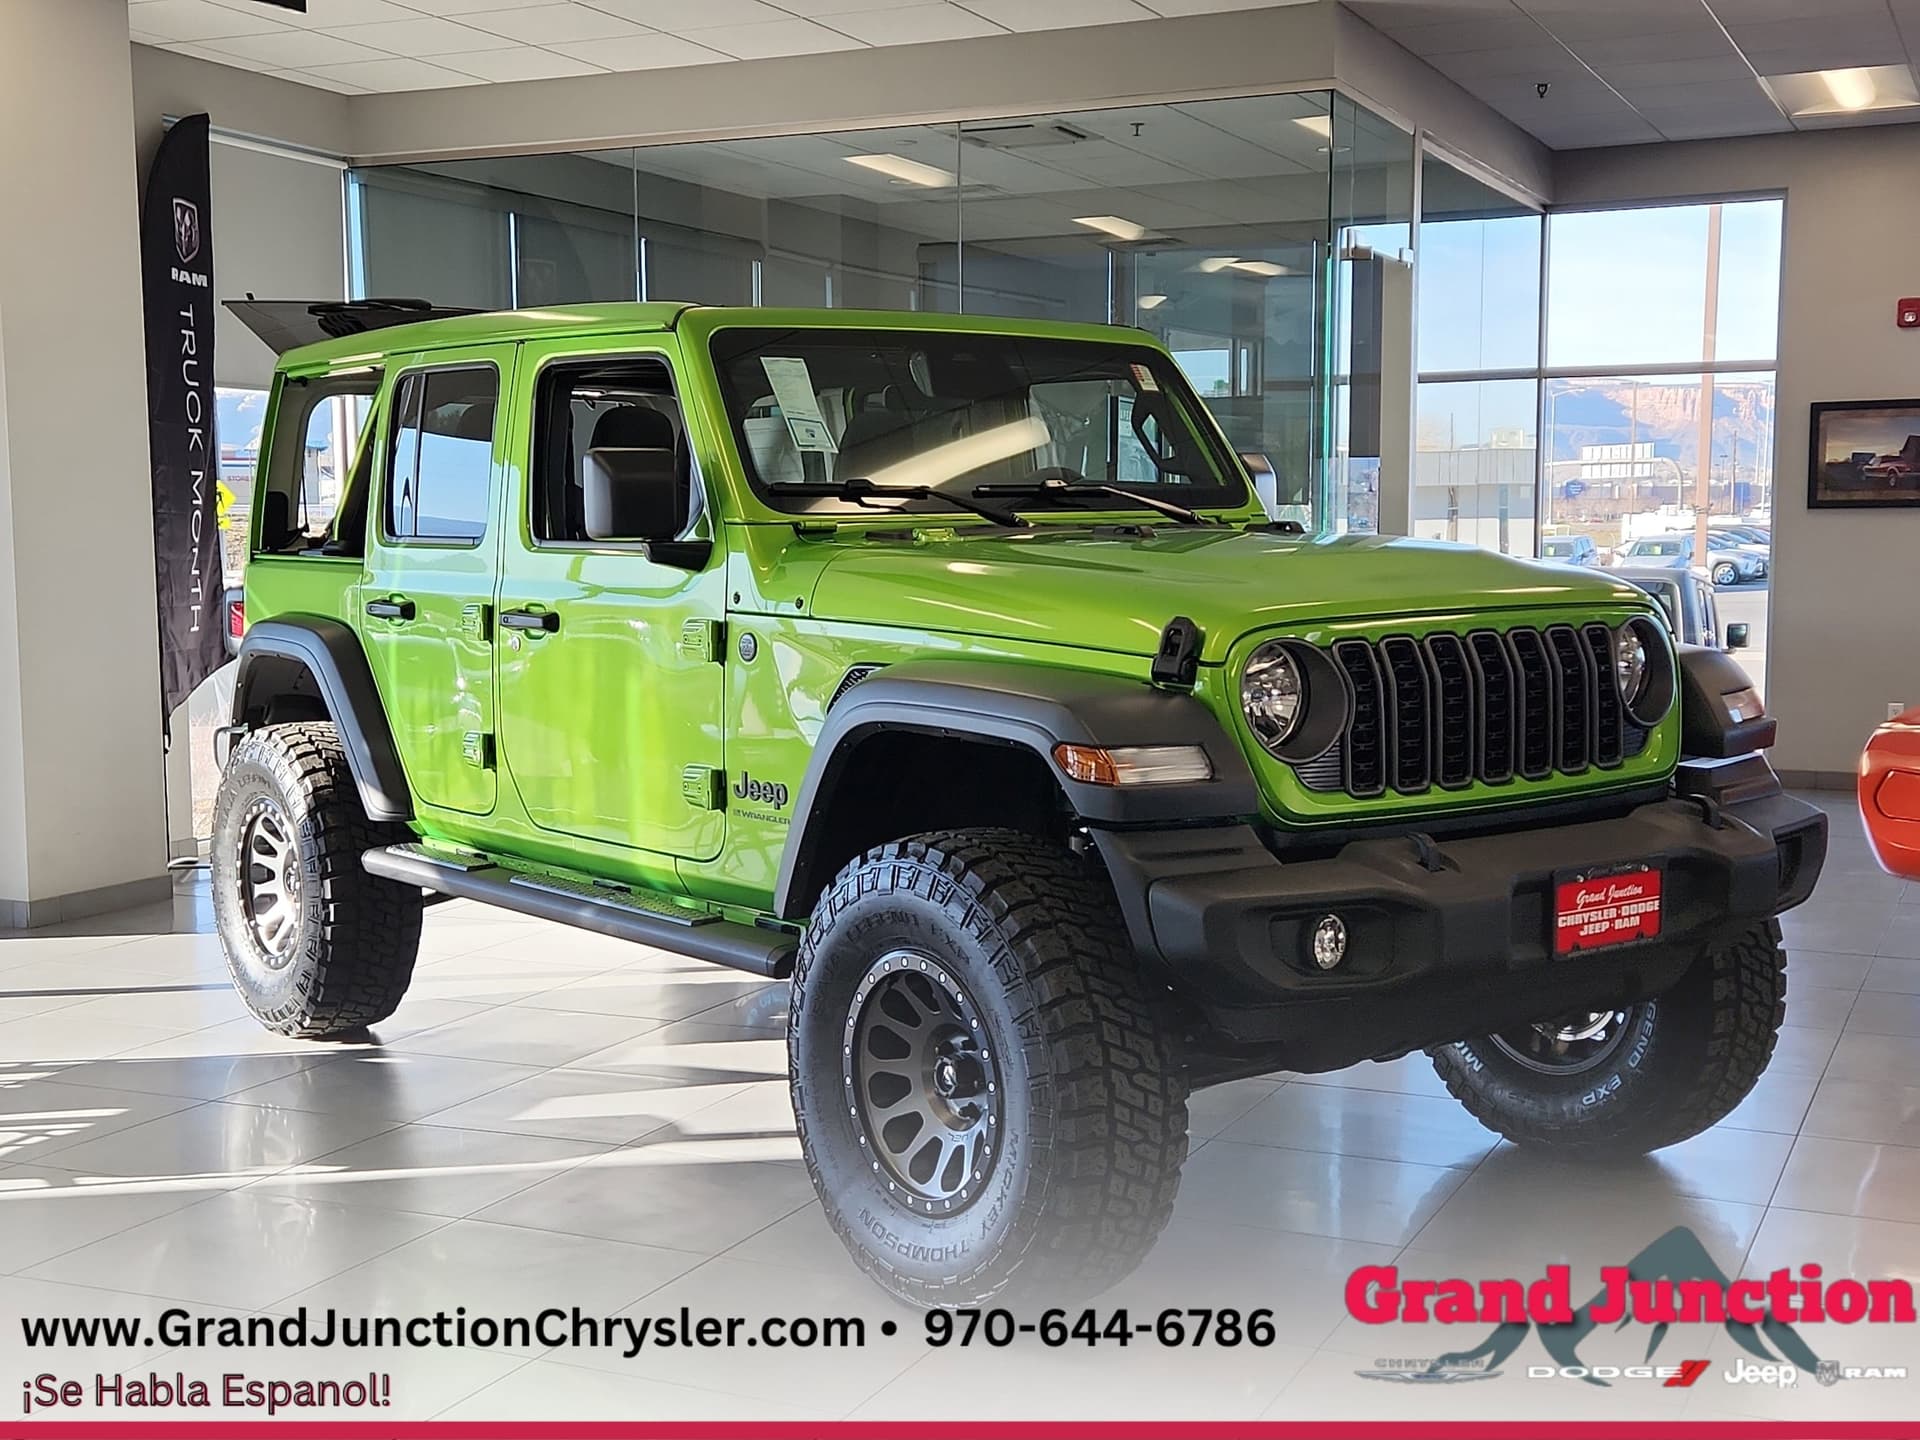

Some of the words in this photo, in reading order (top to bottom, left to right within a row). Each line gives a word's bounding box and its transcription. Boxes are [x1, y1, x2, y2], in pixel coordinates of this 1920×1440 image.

[171, 266, 208, 288] RAM
[179, 303, 204, 452] TRUCK
[190, 470, 204, 632] MONTH
[734, 770, 789, 811] Jeep
[1557, 907, 1617, 928] CHRYSLER
[1621, 899, 1660, 917] DODGE
[1576, 887, 1607, 911] Grand
[1607, 883, 1643, 905] Junction
[1579, 921, 1610, 937] JEEP
[1614, 915, 1640, 930] RAM
[1628, 998, 1658, 1070] GEND
[1582, 1073, 1623, 1106] EXP
[857, 1205, 970, 1264] THOMPSON
